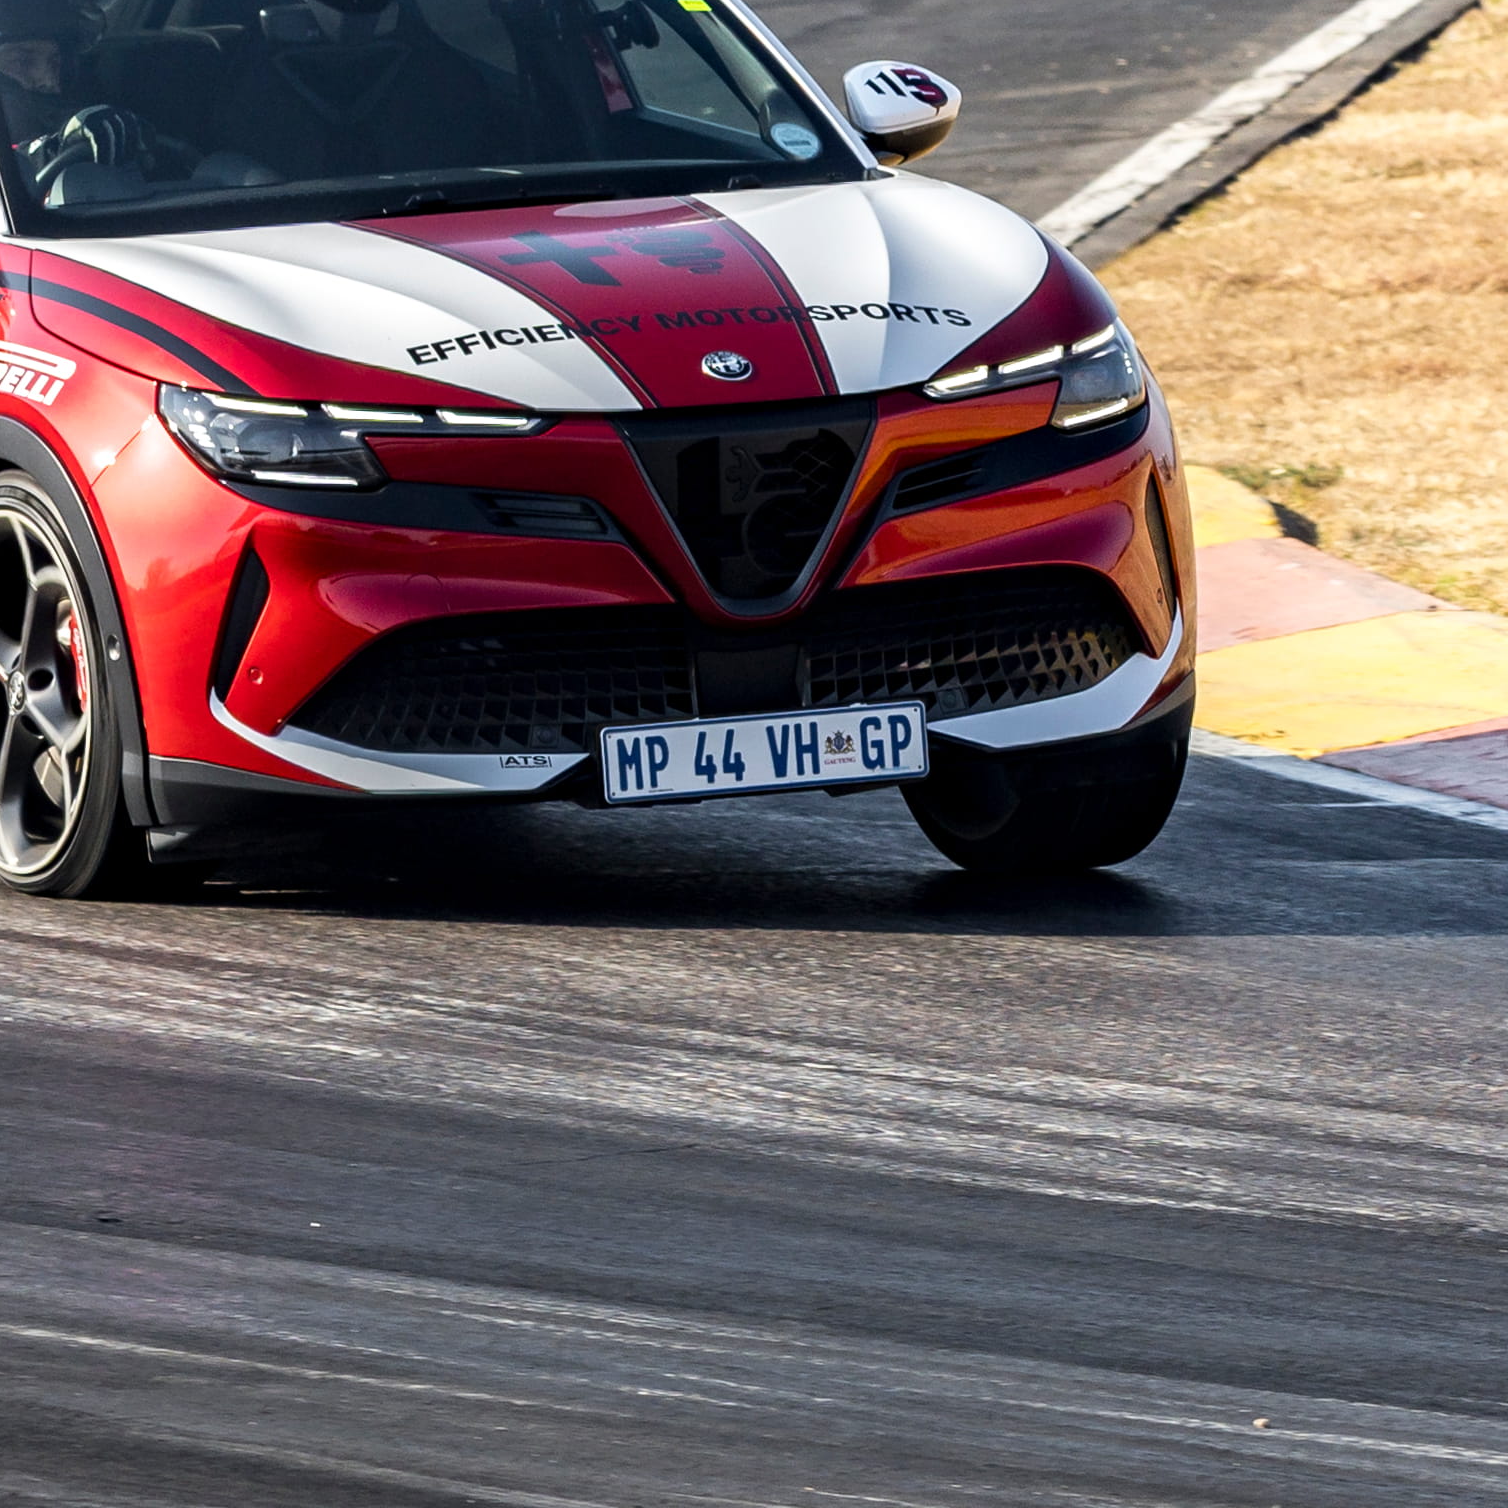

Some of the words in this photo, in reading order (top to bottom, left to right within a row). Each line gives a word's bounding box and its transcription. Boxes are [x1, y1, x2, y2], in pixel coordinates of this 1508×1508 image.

[406, 315, 641, 366] EFFICIENCY
[654, 302, 973, 330] MOTORSPORTS
[505, 755, 547, 765] ATS
[616, 735, 670, 792] MP
[694, 728, 746, 784] 44
[765, 721, 821, 778] VH
[859, 714, 912, 770] GP
